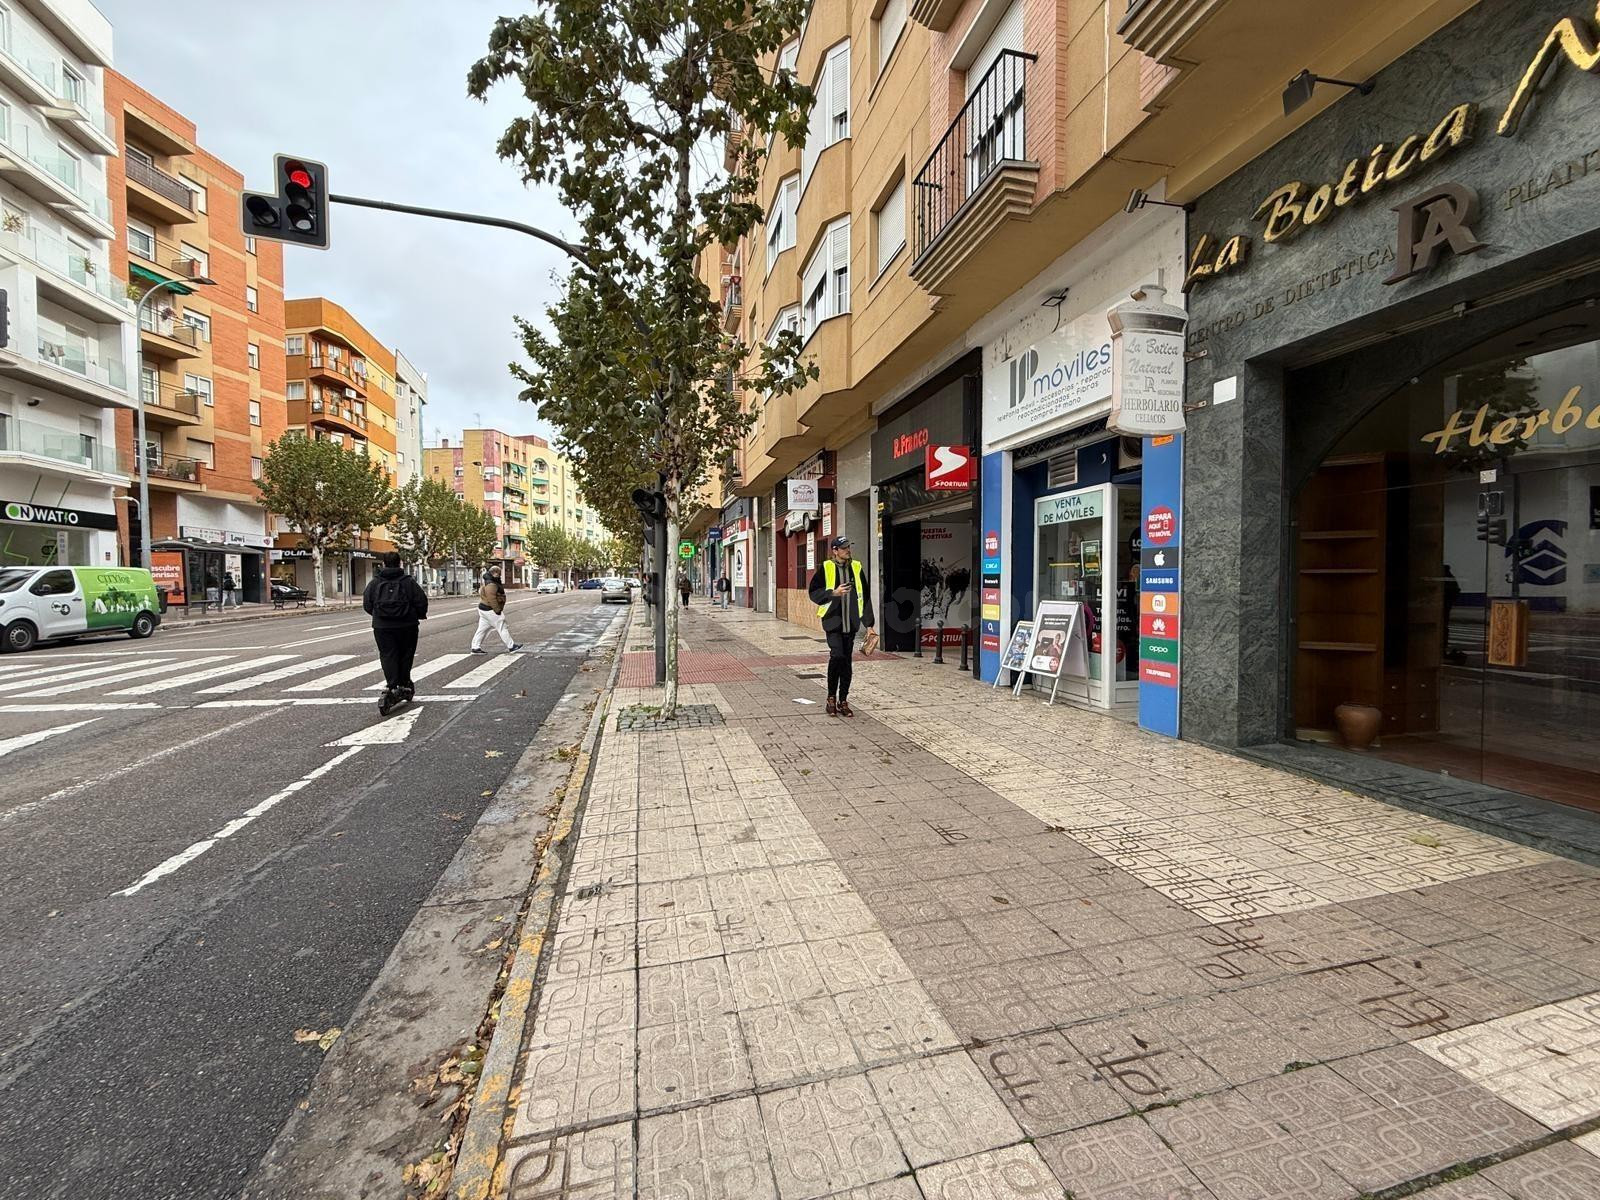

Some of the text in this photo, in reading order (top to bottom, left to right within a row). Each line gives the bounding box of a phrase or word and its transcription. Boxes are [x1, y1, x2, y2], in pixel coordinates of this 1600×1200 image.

[1181, 234, 1249, 292] La
[1251, 101, 1480, 243] Botica
[1187, 243, 1397, 348] CENTRO DE DIETETICA
[1125, 336, 1179, 356] La Botica
[1033, 343, 1111, 397] móviles
[1129, 358, 1175, 375] Natural
[1062, 397, 1082, 408] mano
[1123, 398, 1180, 413] HERBOLARIO
[930, 480, 968, 488] SPORTIUM
[1054, 496, 1082, 510] VENTA
[1043, 506, 1095, 524] DE MÓVILES
[1147, 511, 1172, 522] REPARA
[1145, 576, 1174, 585] SAMSUNG
